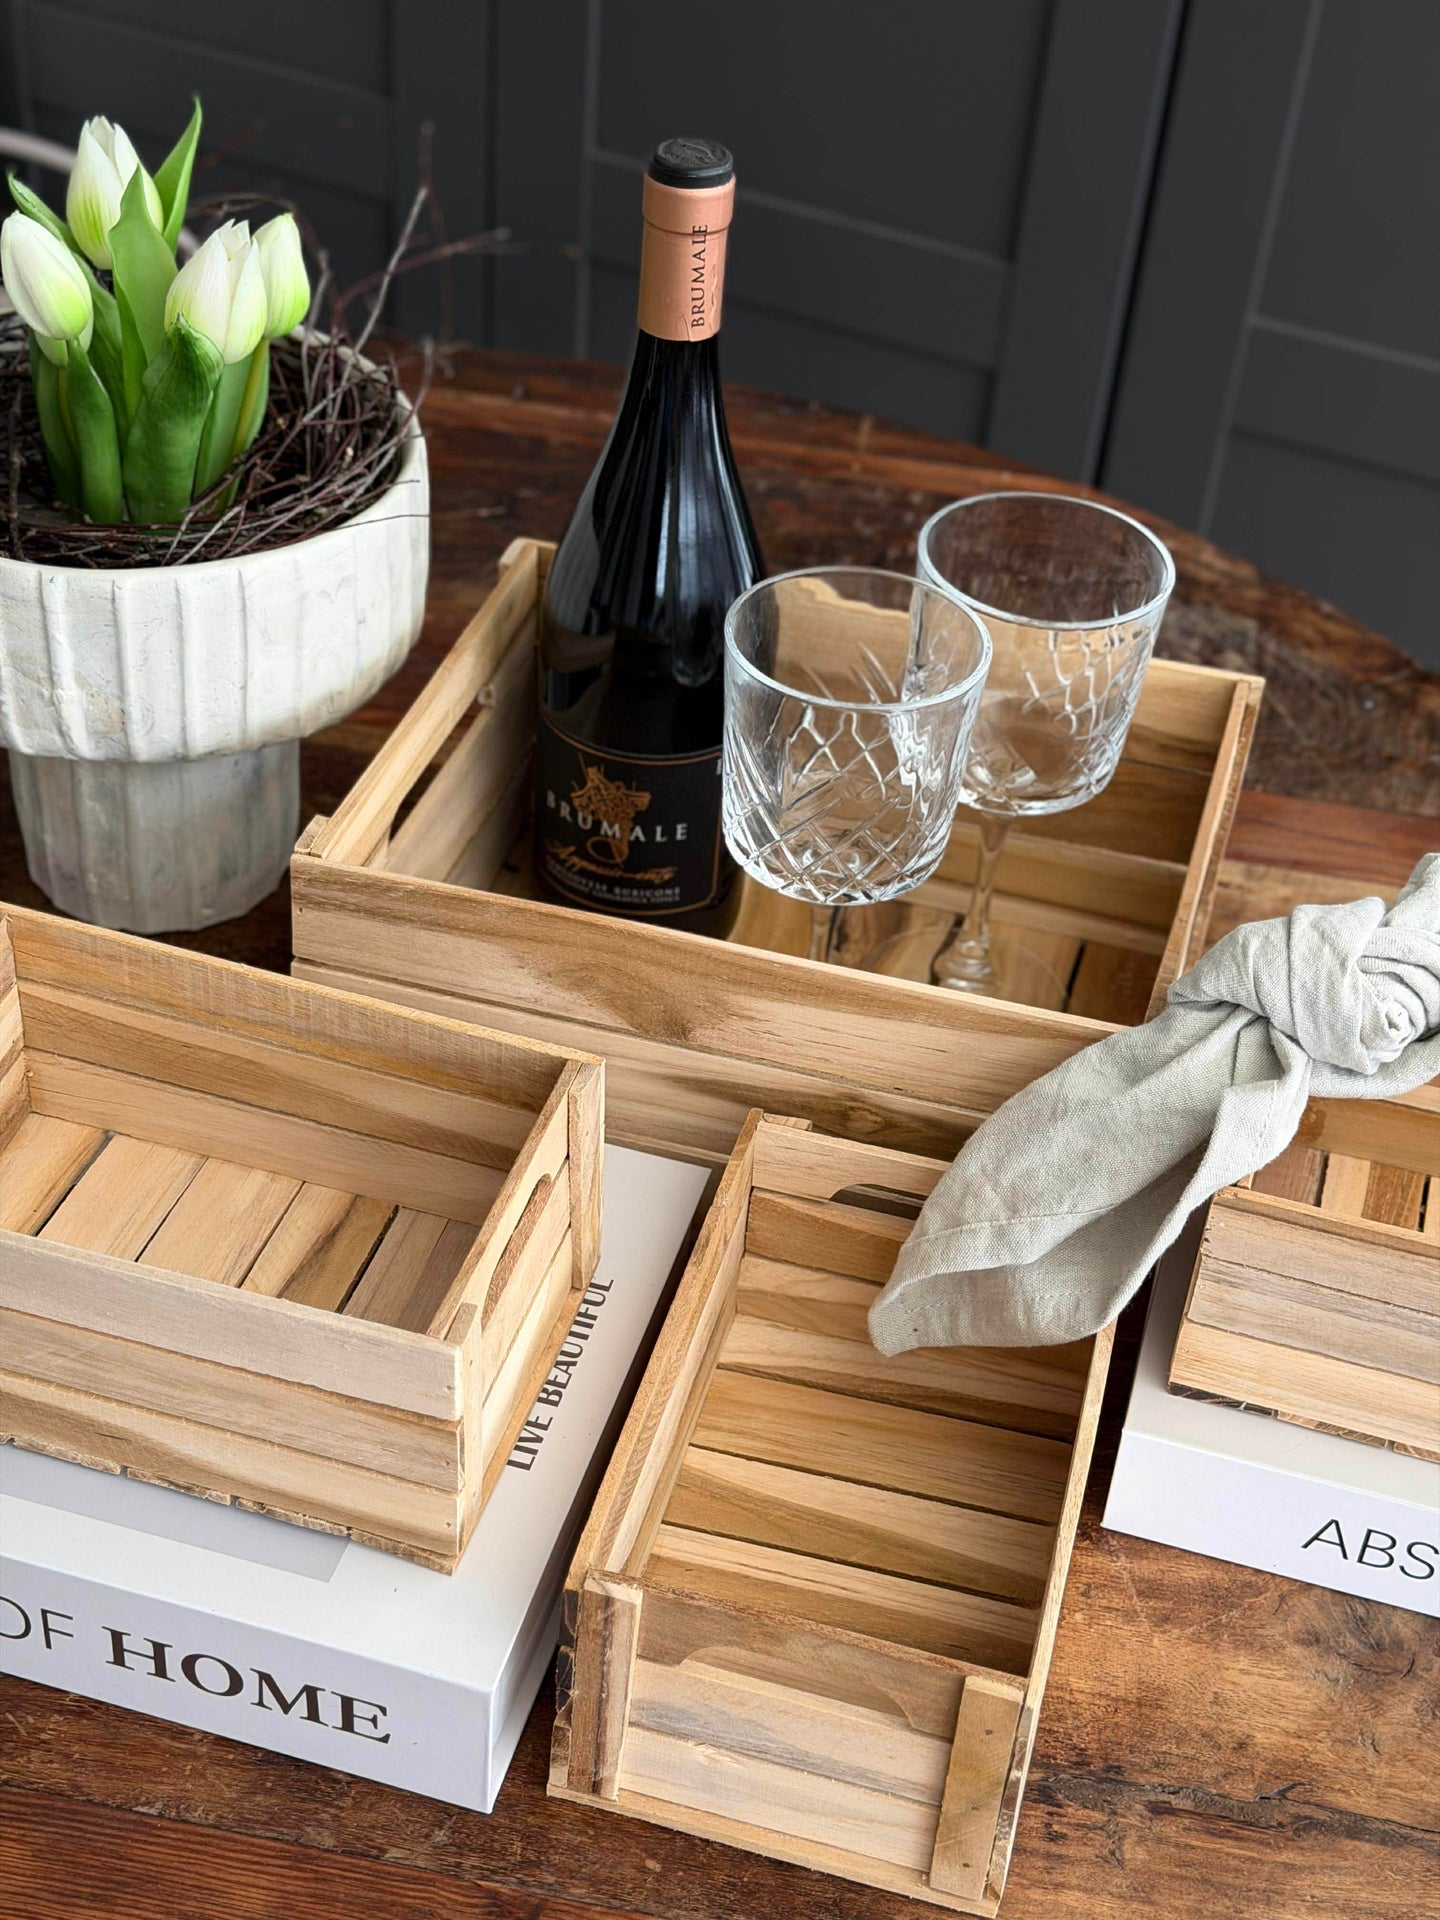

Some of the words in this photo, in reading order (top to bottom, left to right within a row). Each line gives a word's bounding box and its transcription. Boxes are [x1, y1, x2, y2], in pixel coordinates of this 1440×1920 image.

[691, 224, 708, 329] BRUMALE
[546, 790, 688, 843] BRUMALE
[506, 1415, 553, 1471] LIVE
[536, 1279, 614, 1407] BEAUTIFUL
[1300, 1518, 1440, 1580] ABS
[0, 1595, 74, 1650] OF
[101, 1625, 391, 1744] HOME
